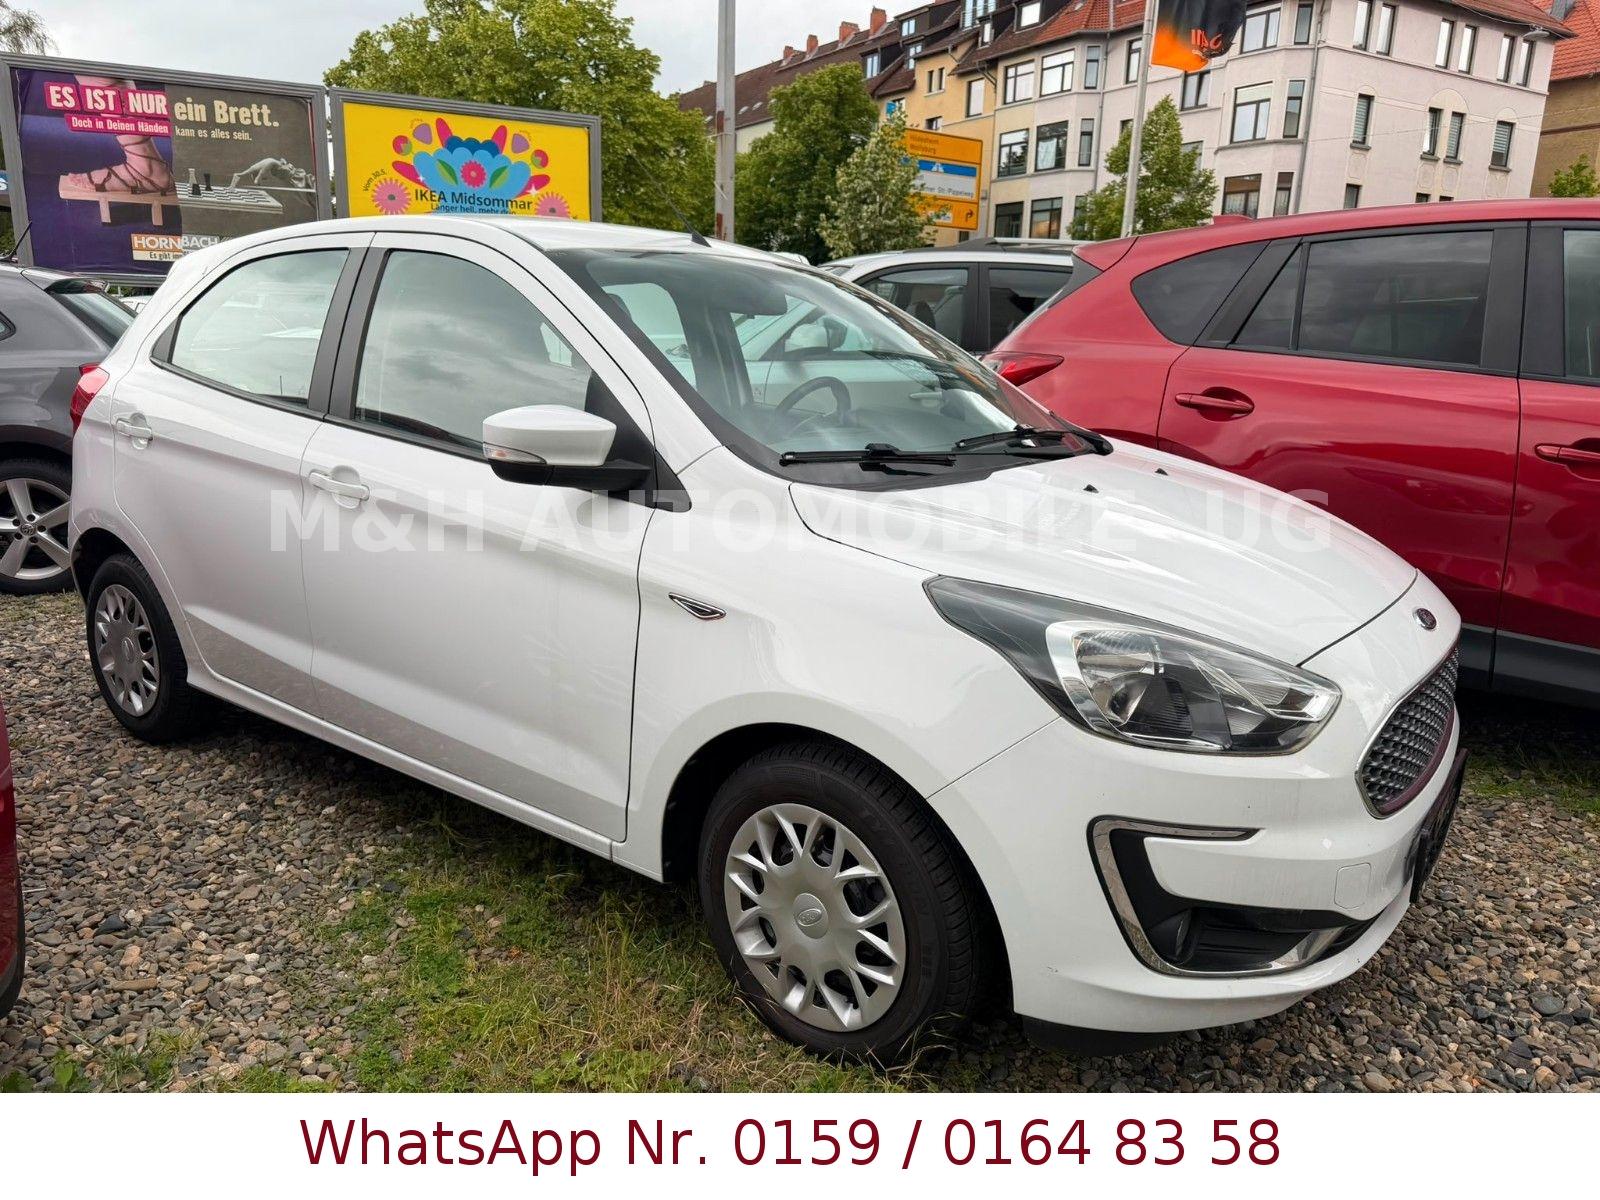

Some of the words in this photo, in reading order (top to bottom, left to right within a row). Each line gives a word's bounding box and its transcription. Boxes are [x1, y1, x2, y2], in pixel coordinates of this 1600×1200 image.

[49, 85, 76, 108] ES
[85, 88, 116, 111] IST
[127, 92, 168, 115] NUR
[174, 97, 207, 122] ein
[213, 100, 279, 127] Brett.
[72, 117, 92, 128] Doch
[96, 118, 104, 129] in
[106, 119, 135, 131] Deinen
[138, 121, 168, 133] Händen
[175, 126, 195, 137] kann
[197, 129, 208, 137] es
[211, 128, 230, 139] alles
[233, 130, 252, 140] sein.
[415, 189, 447, 203] IKEA
[451, 192, 533, 210] Midsommar
[134, 236, 218, 249] HORNBACH
[150, 251, 157, 259] Es
